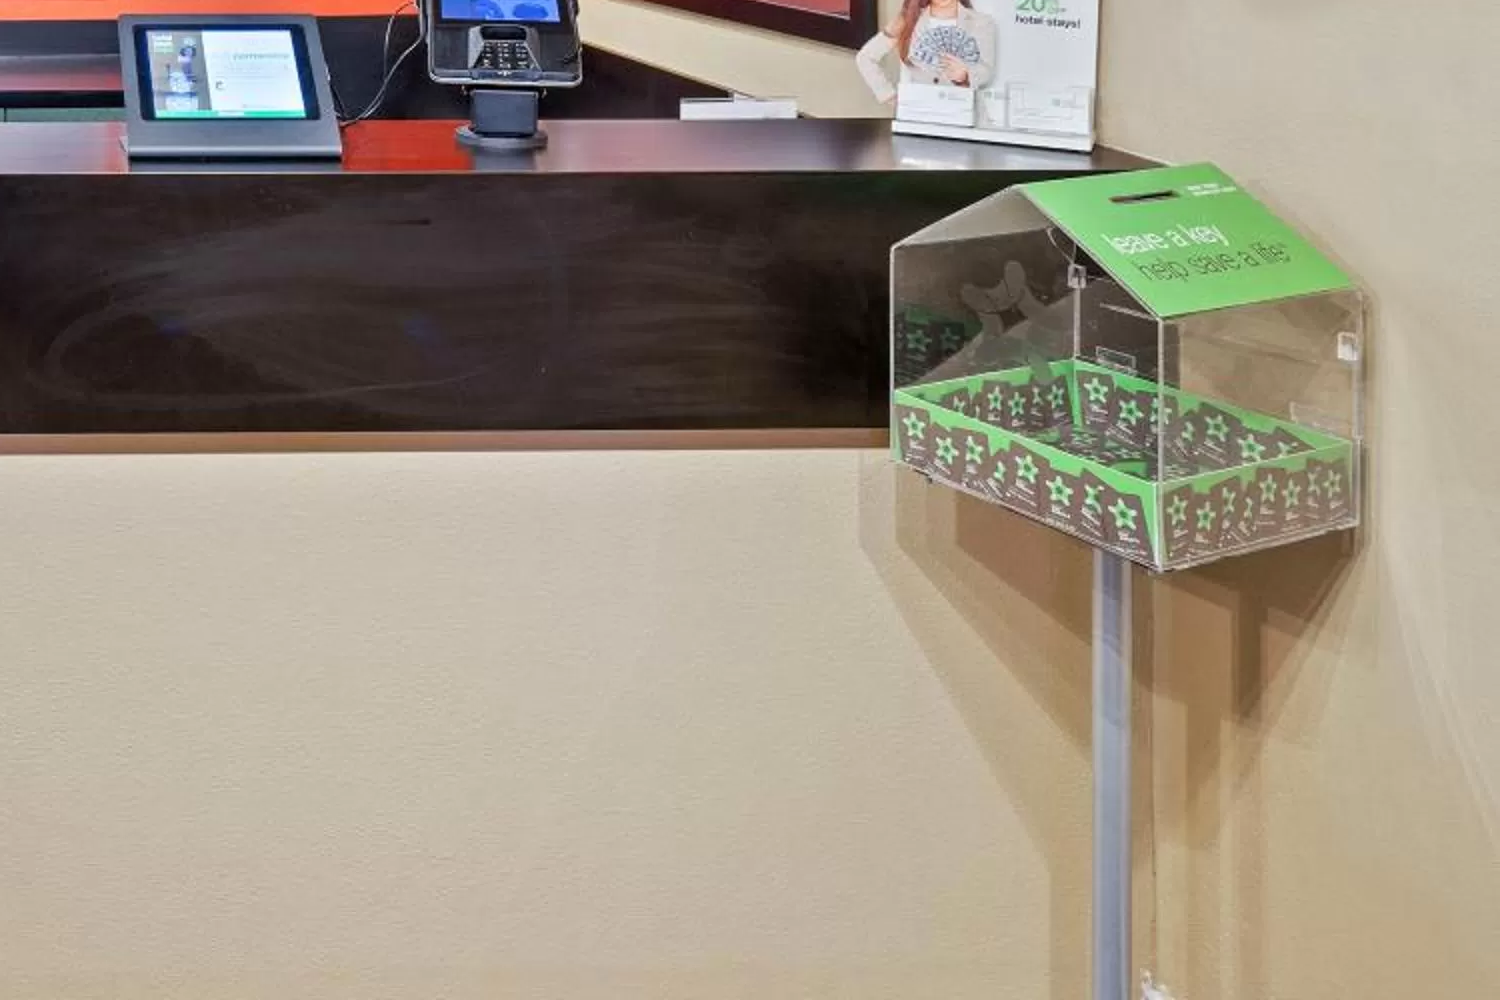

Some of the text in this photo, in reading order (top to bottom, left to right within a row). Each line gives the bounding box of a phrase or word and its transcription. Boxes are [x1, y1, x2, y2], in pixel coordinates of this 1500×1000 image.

[1015, 13, 1043, 25] hotel
[1101, 232, 1169, 256] leave
[1176, 223, 1230, 247] key
[1130, 254, 1190, 283] help
[1187, 250, 1242, 275] save
